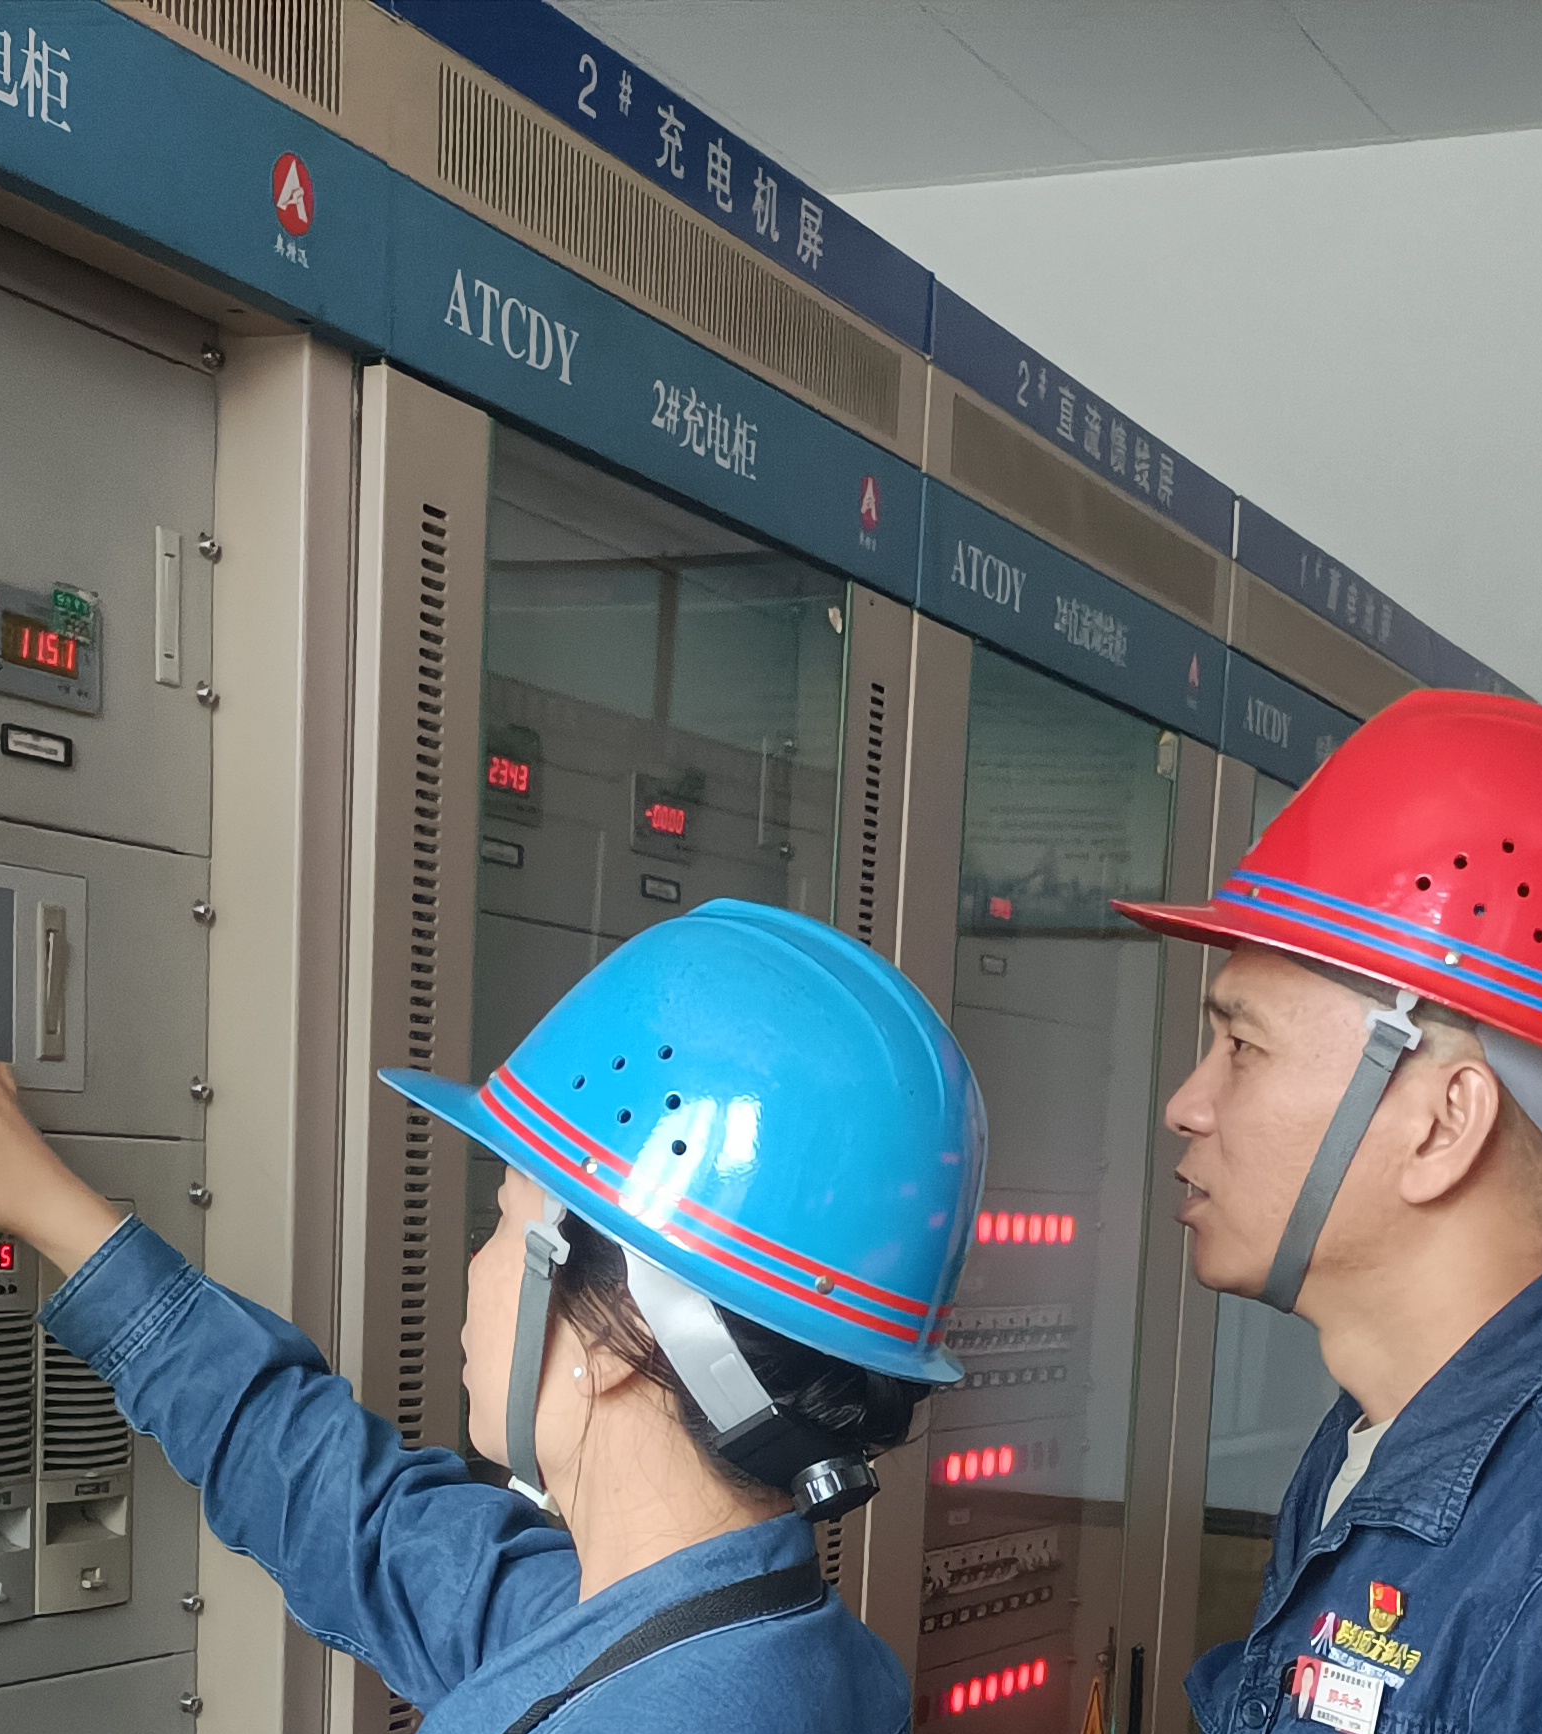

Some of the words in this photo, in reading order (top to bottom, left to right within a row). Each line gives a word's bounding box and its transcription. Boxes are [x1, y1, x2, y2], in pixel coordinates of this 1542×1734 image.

[444, 268, 580, 386] ATCDY
[651, 379, 758, 482] 2#充电柜
[949, 539, 1027, 614] ATCDY
